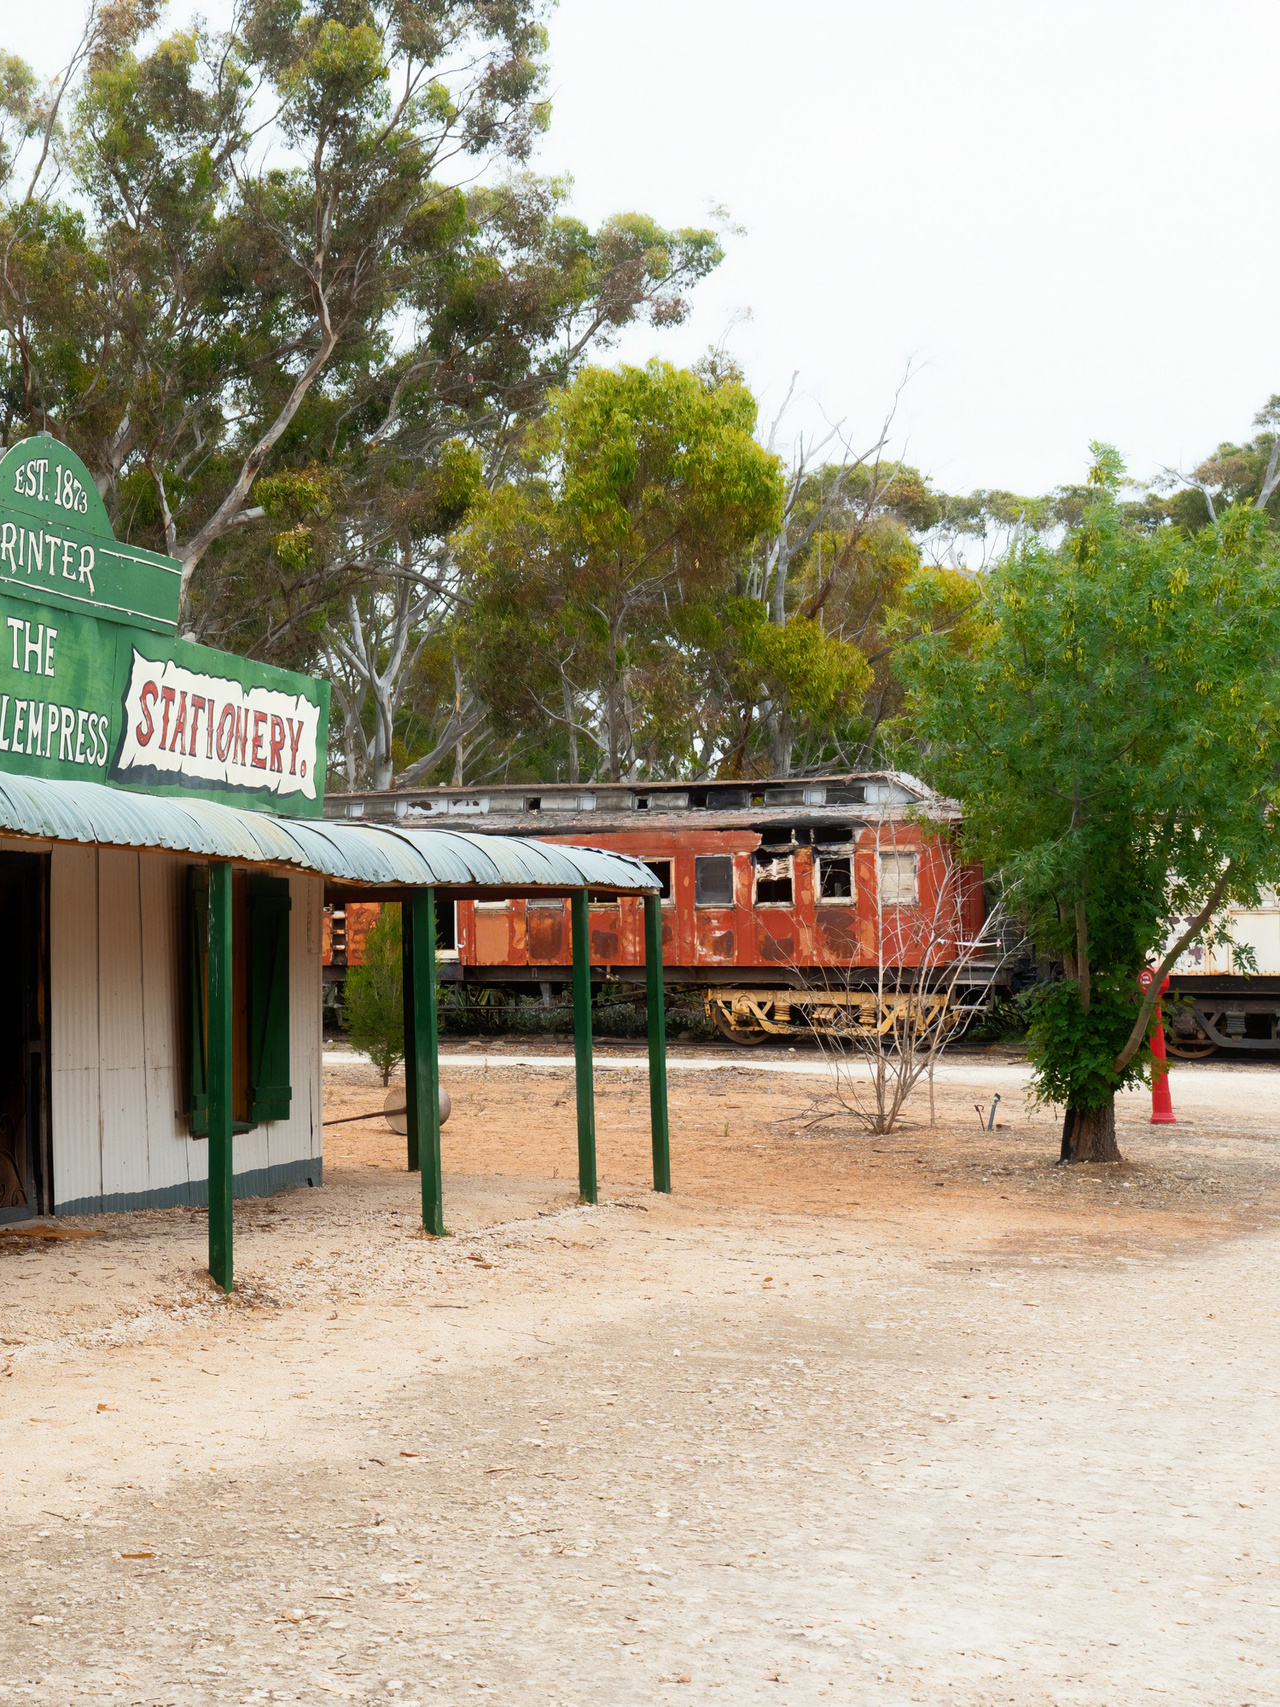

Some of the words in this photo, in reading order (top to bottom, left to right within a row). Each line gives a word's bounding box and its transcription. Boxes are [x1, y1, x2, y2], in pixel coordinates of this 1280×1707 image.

[14, 458, 50, 502] EST.
[54, 464, 88, 515] 1873
[7, 615, 58, 678] THE
[136, 680, 307, 778] STATIONERY.
